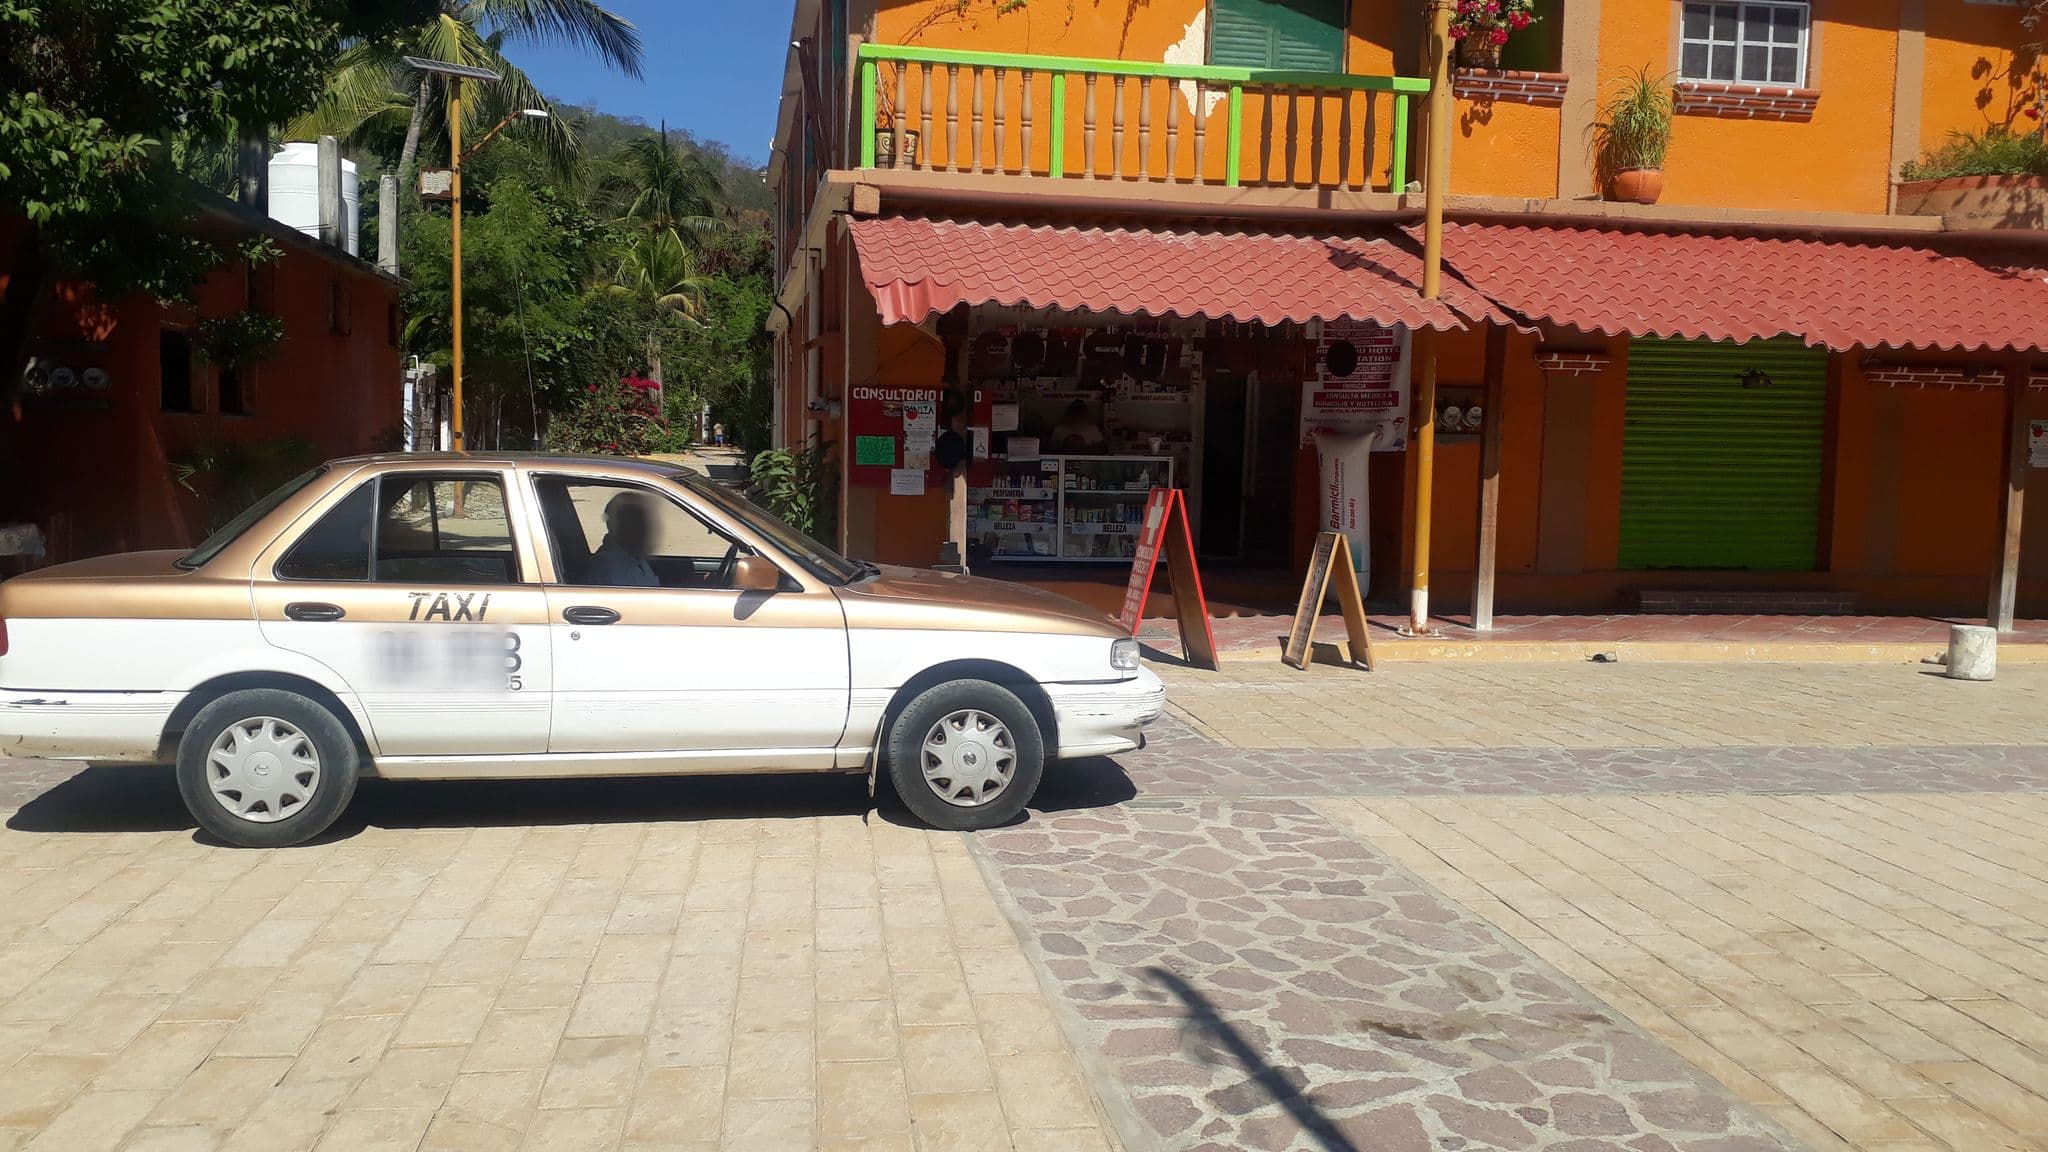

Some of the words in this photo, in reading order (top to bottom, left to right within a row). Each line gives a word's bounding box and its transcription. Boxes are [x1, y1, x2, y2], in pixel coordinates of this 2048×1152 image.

[853, 387, 936, 402] CONSULTORIO
[993, 489, 1024, 498] PERFUMERIA
[1329, 484, 1340, 530] Barmicil
[993, 522, 1015, 531] BELLEZA
[1102, 523, 1127, 533] BELLEZA
[408, 592, 491, 621] TAXI
